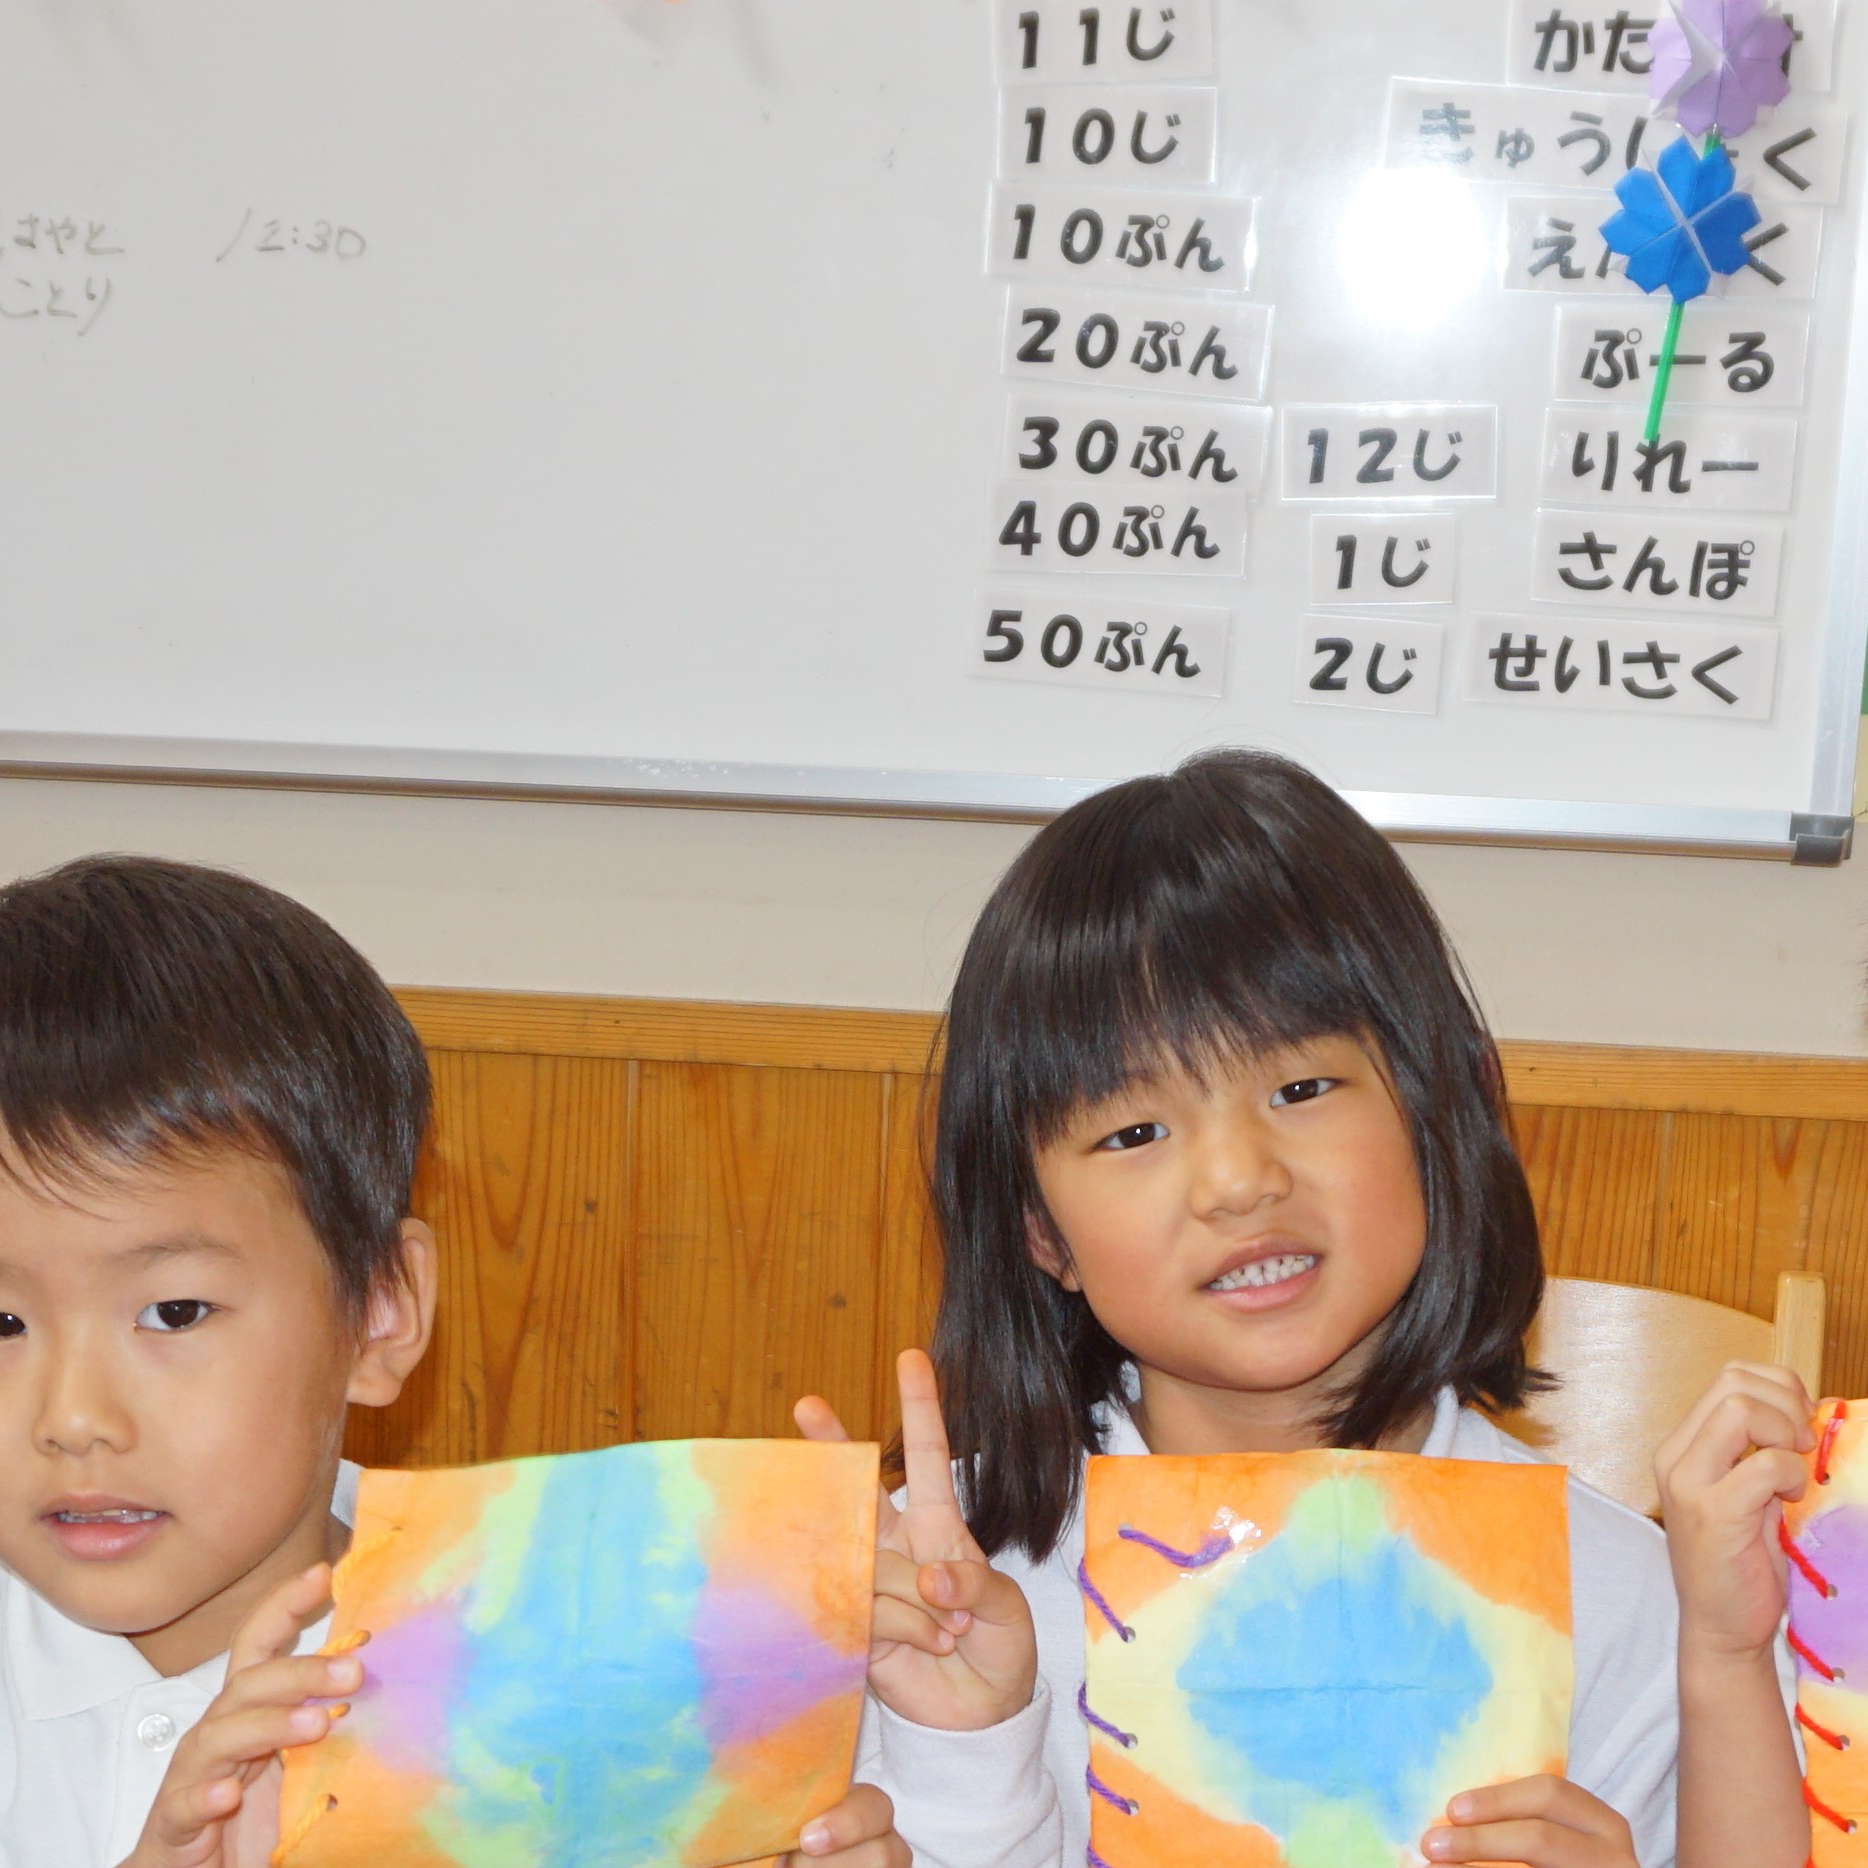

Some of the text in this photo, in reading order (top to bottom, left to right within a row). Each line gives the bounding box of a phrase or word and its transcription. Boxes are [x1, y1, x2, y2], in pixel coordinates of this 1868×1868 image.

[1018, 7, 1175, 69] 11じ
[1534, 9, 1803, 79] かた
[1024, 108, 1180, 166] 10じ
[215, 207, 368, 263] 12:30
[1011, 205, 1224, 272] 10ぷん
[1527, 216, 1790, 286] えく
[1017, 310, 1235, 379] 20ぷん
[1580, 328, 1775, 393] ぷーる
[1018, 416, 1238, 483] 30ぷん
[1307, 428, 1462, 485] 12じ
[1572, 431, 1759, 494] りれー
[999, 503, 1219, 558] 40ぷん
[1335, 535, 1430, 591] 1じ
[1558, 531, 1756, 601] さんぽ
[984, 611, 1200, 677] 50ぷん
[1309, 637, 1417, 695] 2じ
[1488, 632, 1744, 705] せいさく
